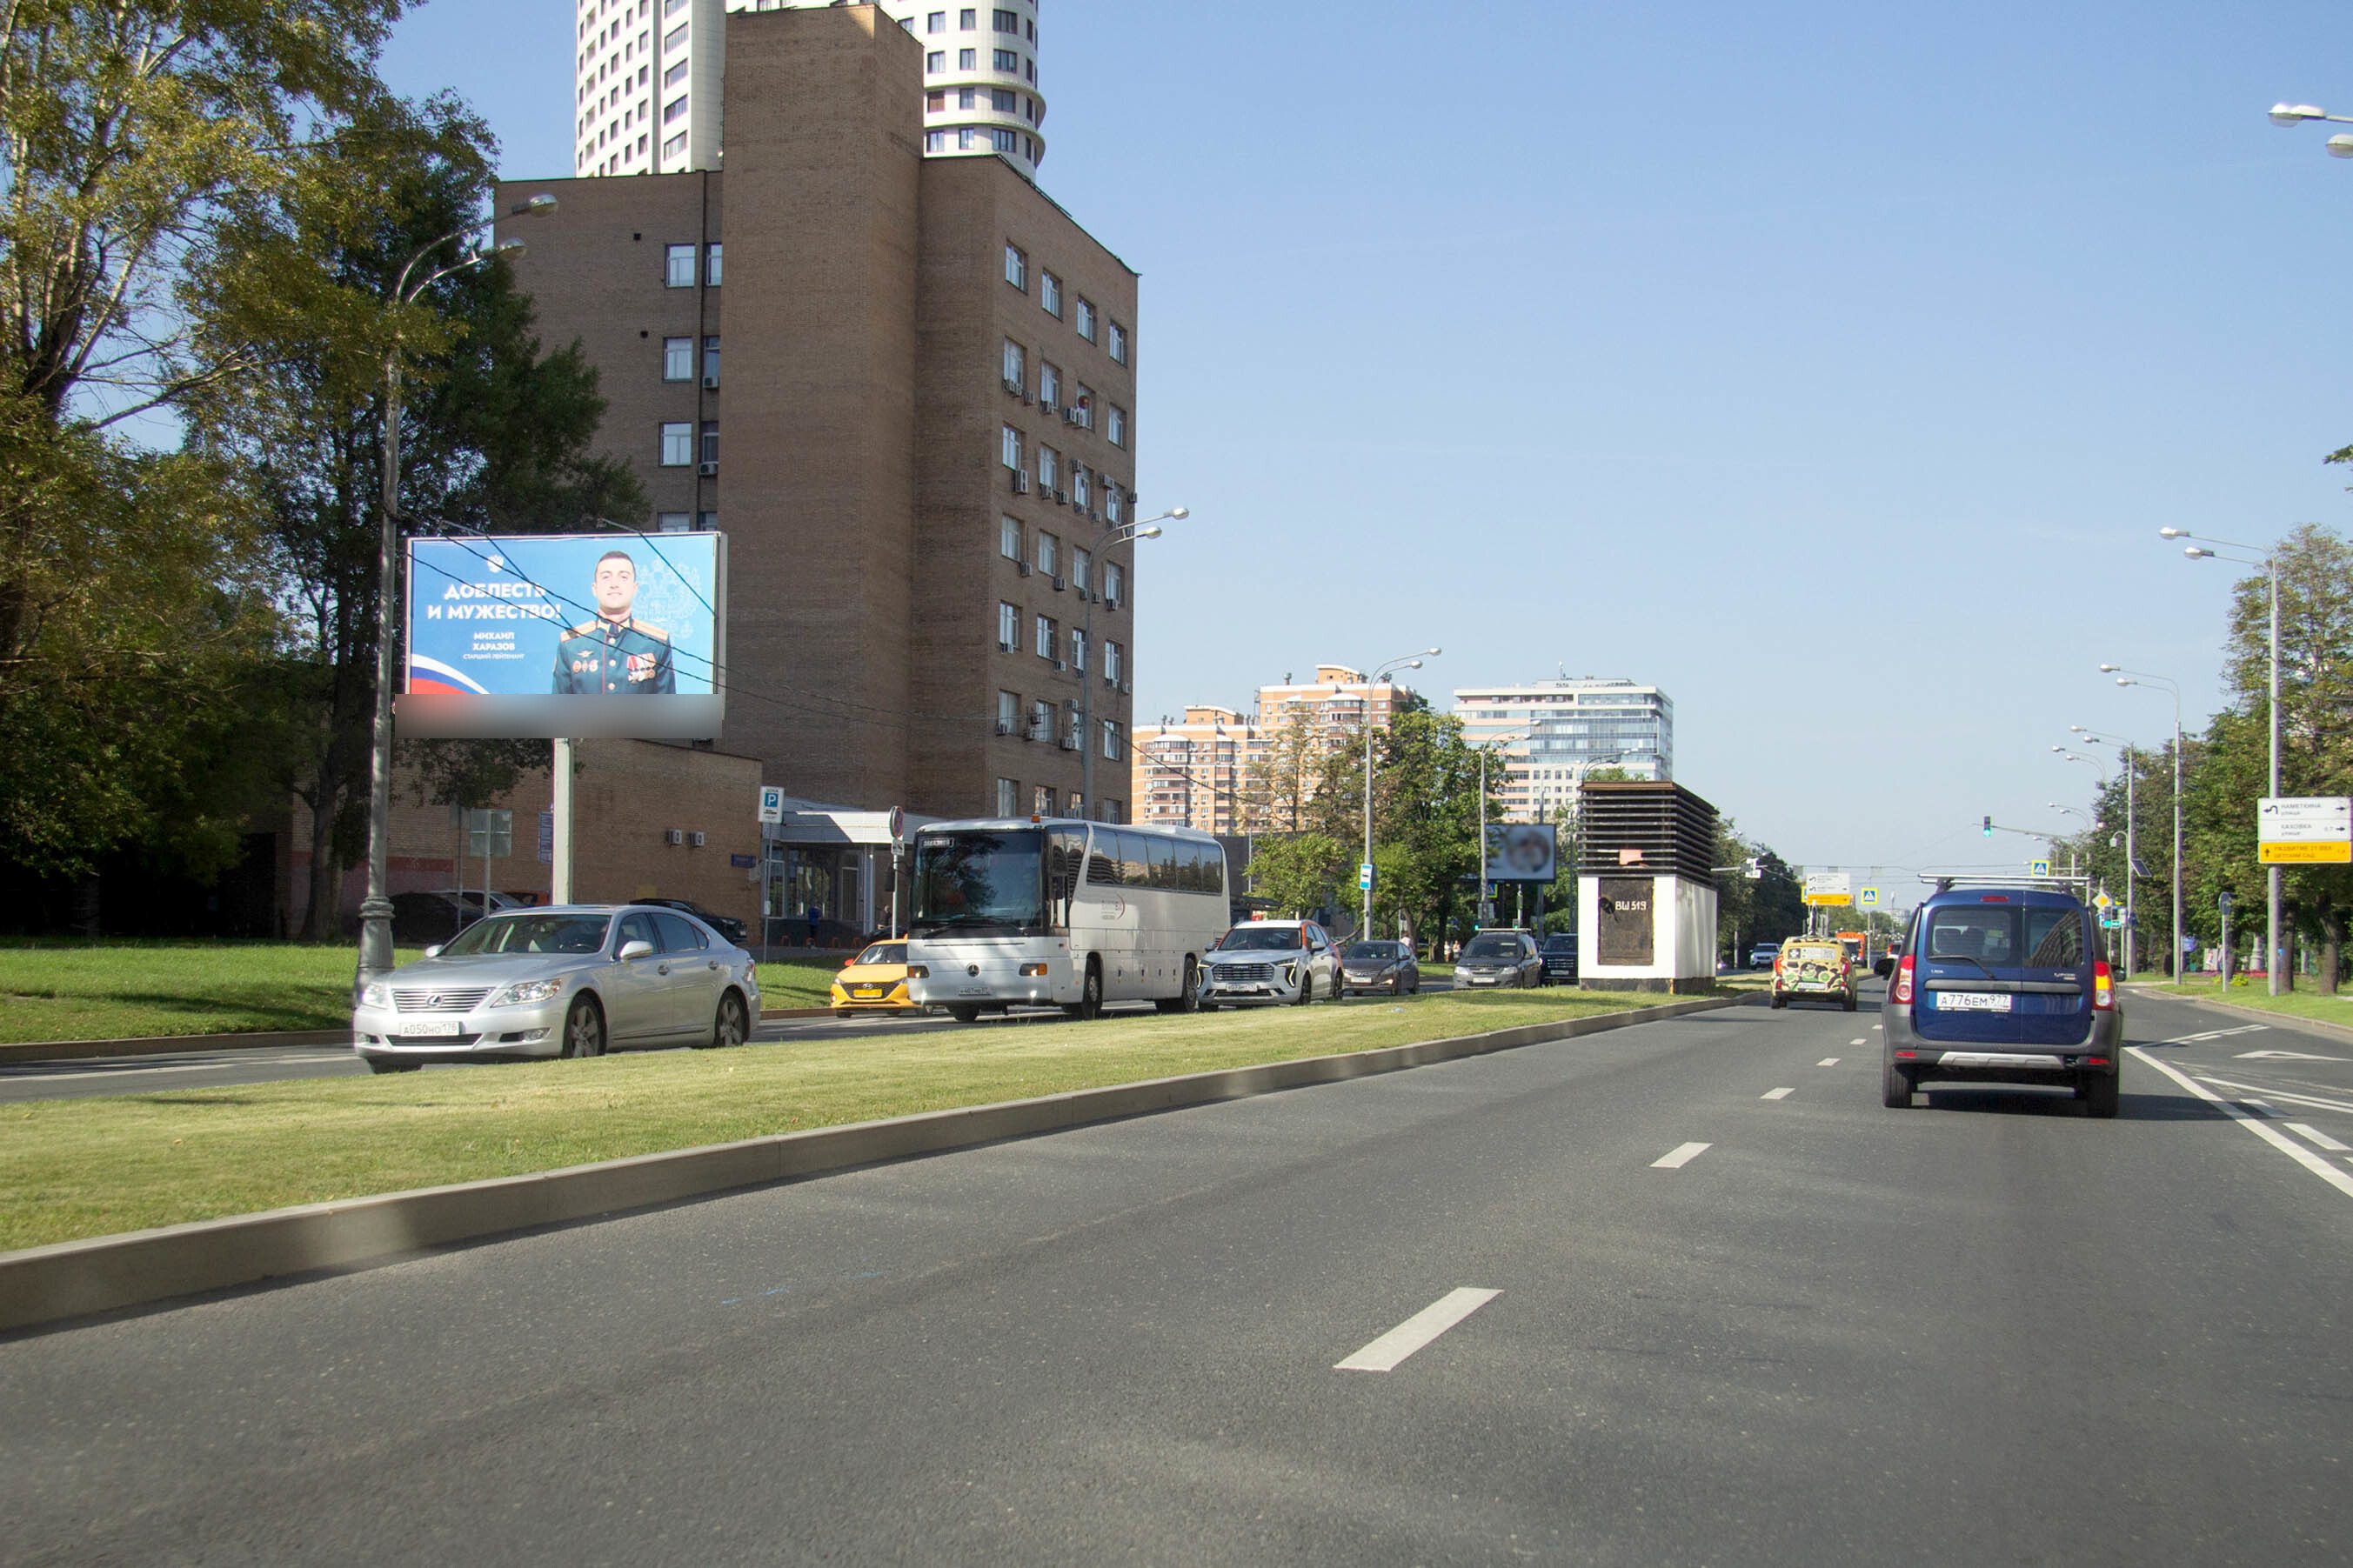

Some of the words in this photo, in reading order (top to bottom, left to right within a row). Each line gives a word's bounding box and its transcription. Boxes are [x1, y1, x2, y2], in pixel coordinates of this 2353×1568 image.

[444, 583, 545, 600] ДОБЛЕСТЬ
[427, 604, 442, 619] И
[447, 604, 561, 619] МУЖЕСТВО!
[473, 631, 515, 640] МИХАИЛ
[1631, 901, 1647, 911] 519
